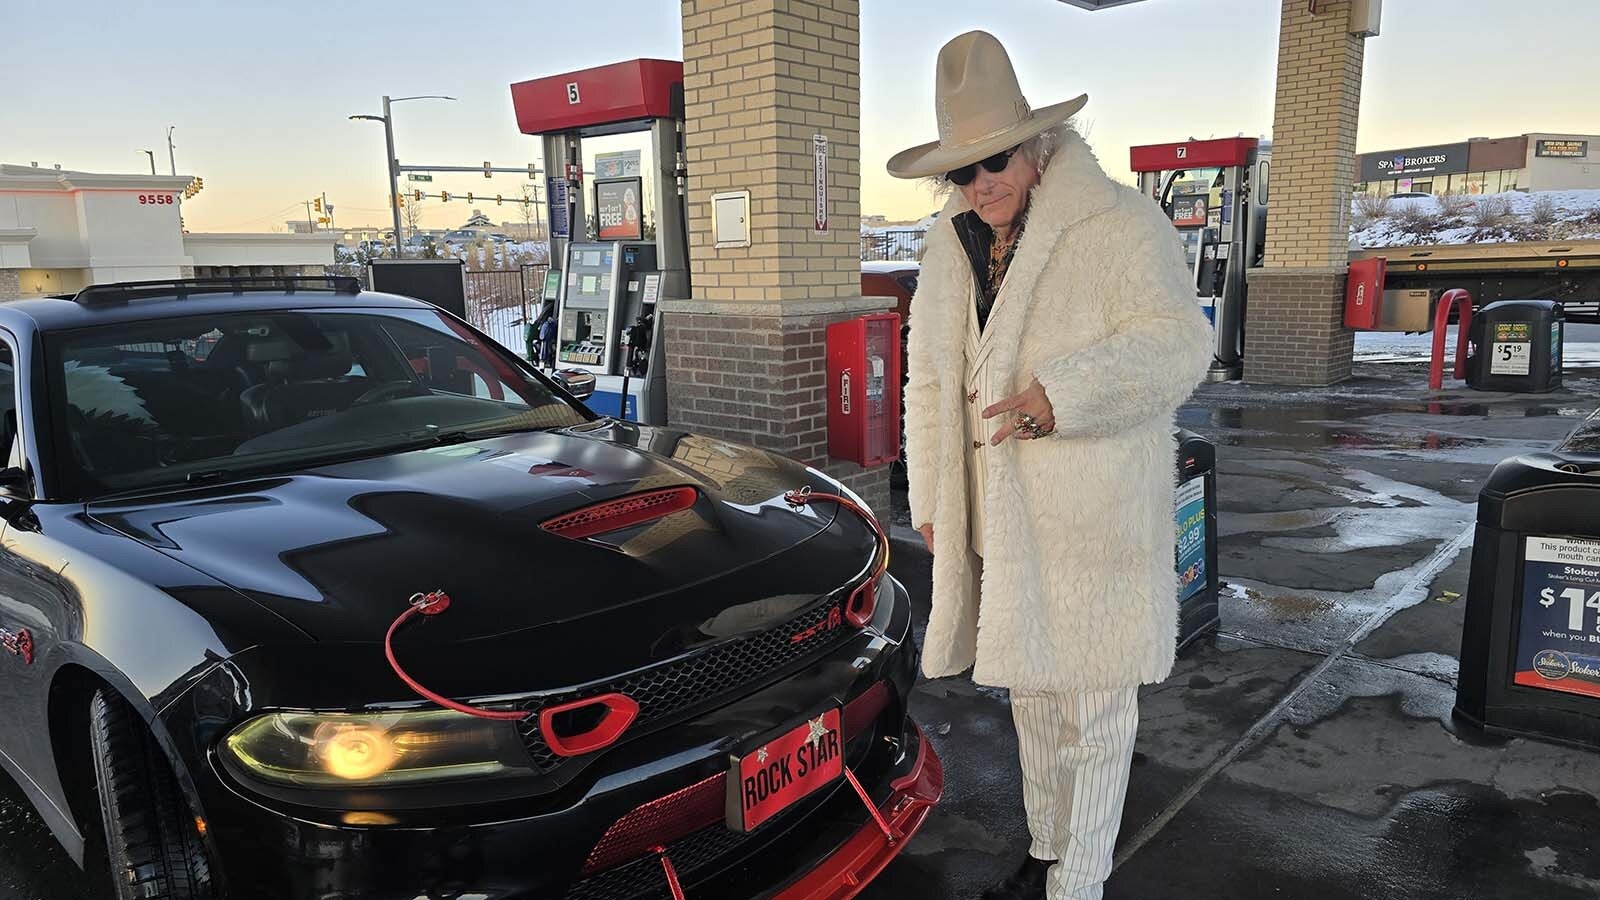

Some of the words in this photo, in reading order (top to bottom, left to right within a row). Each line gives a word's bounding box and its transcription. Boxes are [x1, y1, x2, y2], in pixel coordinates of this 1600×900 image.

[570, 85, 578, 102] 5
[1178, 148, 1185, 157] 7
[1378, 160, 1394, 169] SPA
[1404, 154, 1447, 167] BROKERS
[138, 194, 174, 205] 9558
[600, 213, 623, 226] FREE
[1188, 508, 1206, 528] PLUS
[1541, 542, 1557, 551] This
[1559, 544, 1591, 554] product
[1557, 552, 1584, 561] mouth
[1570, 575, 1584, 583] Long
[1542, 629, 1567, 639] when
[1569, 634, 1586, 642] you
[743, 753, 793, 811] ROCK
[796, 728, 839, 778] STAR
